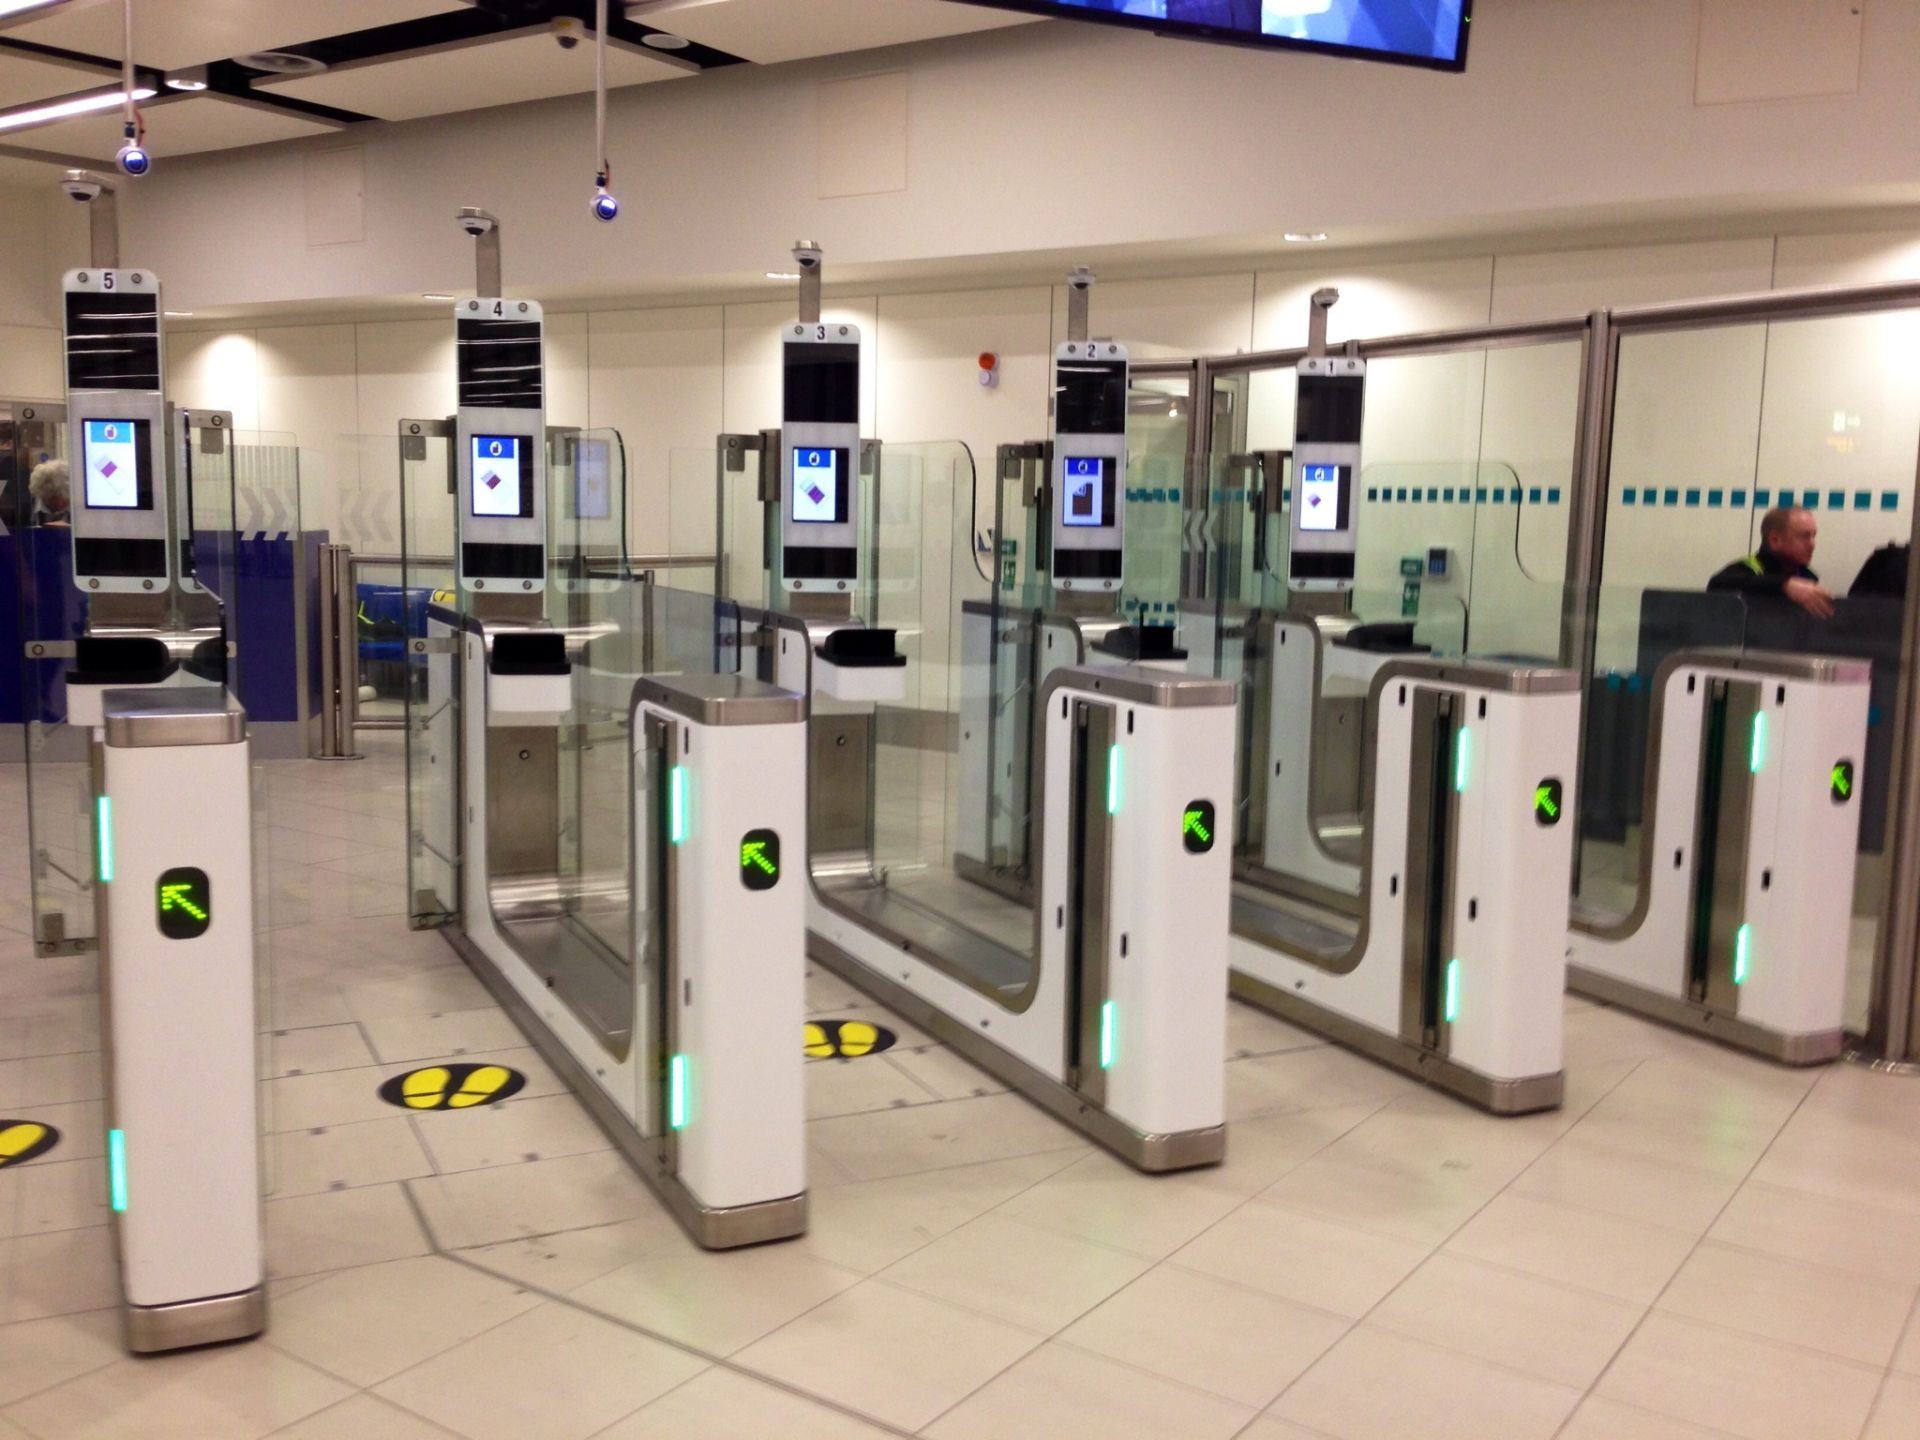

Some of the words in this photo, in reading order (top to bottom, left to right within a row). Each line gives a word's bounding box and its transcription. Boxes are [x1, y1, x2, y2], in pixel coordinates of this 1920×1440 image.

[104, 272, 113, 290] 5
[493, 301, 503, 317] 4
[817, 326, 825, 340] 3
[1087, 344, 1096, 358] 2
